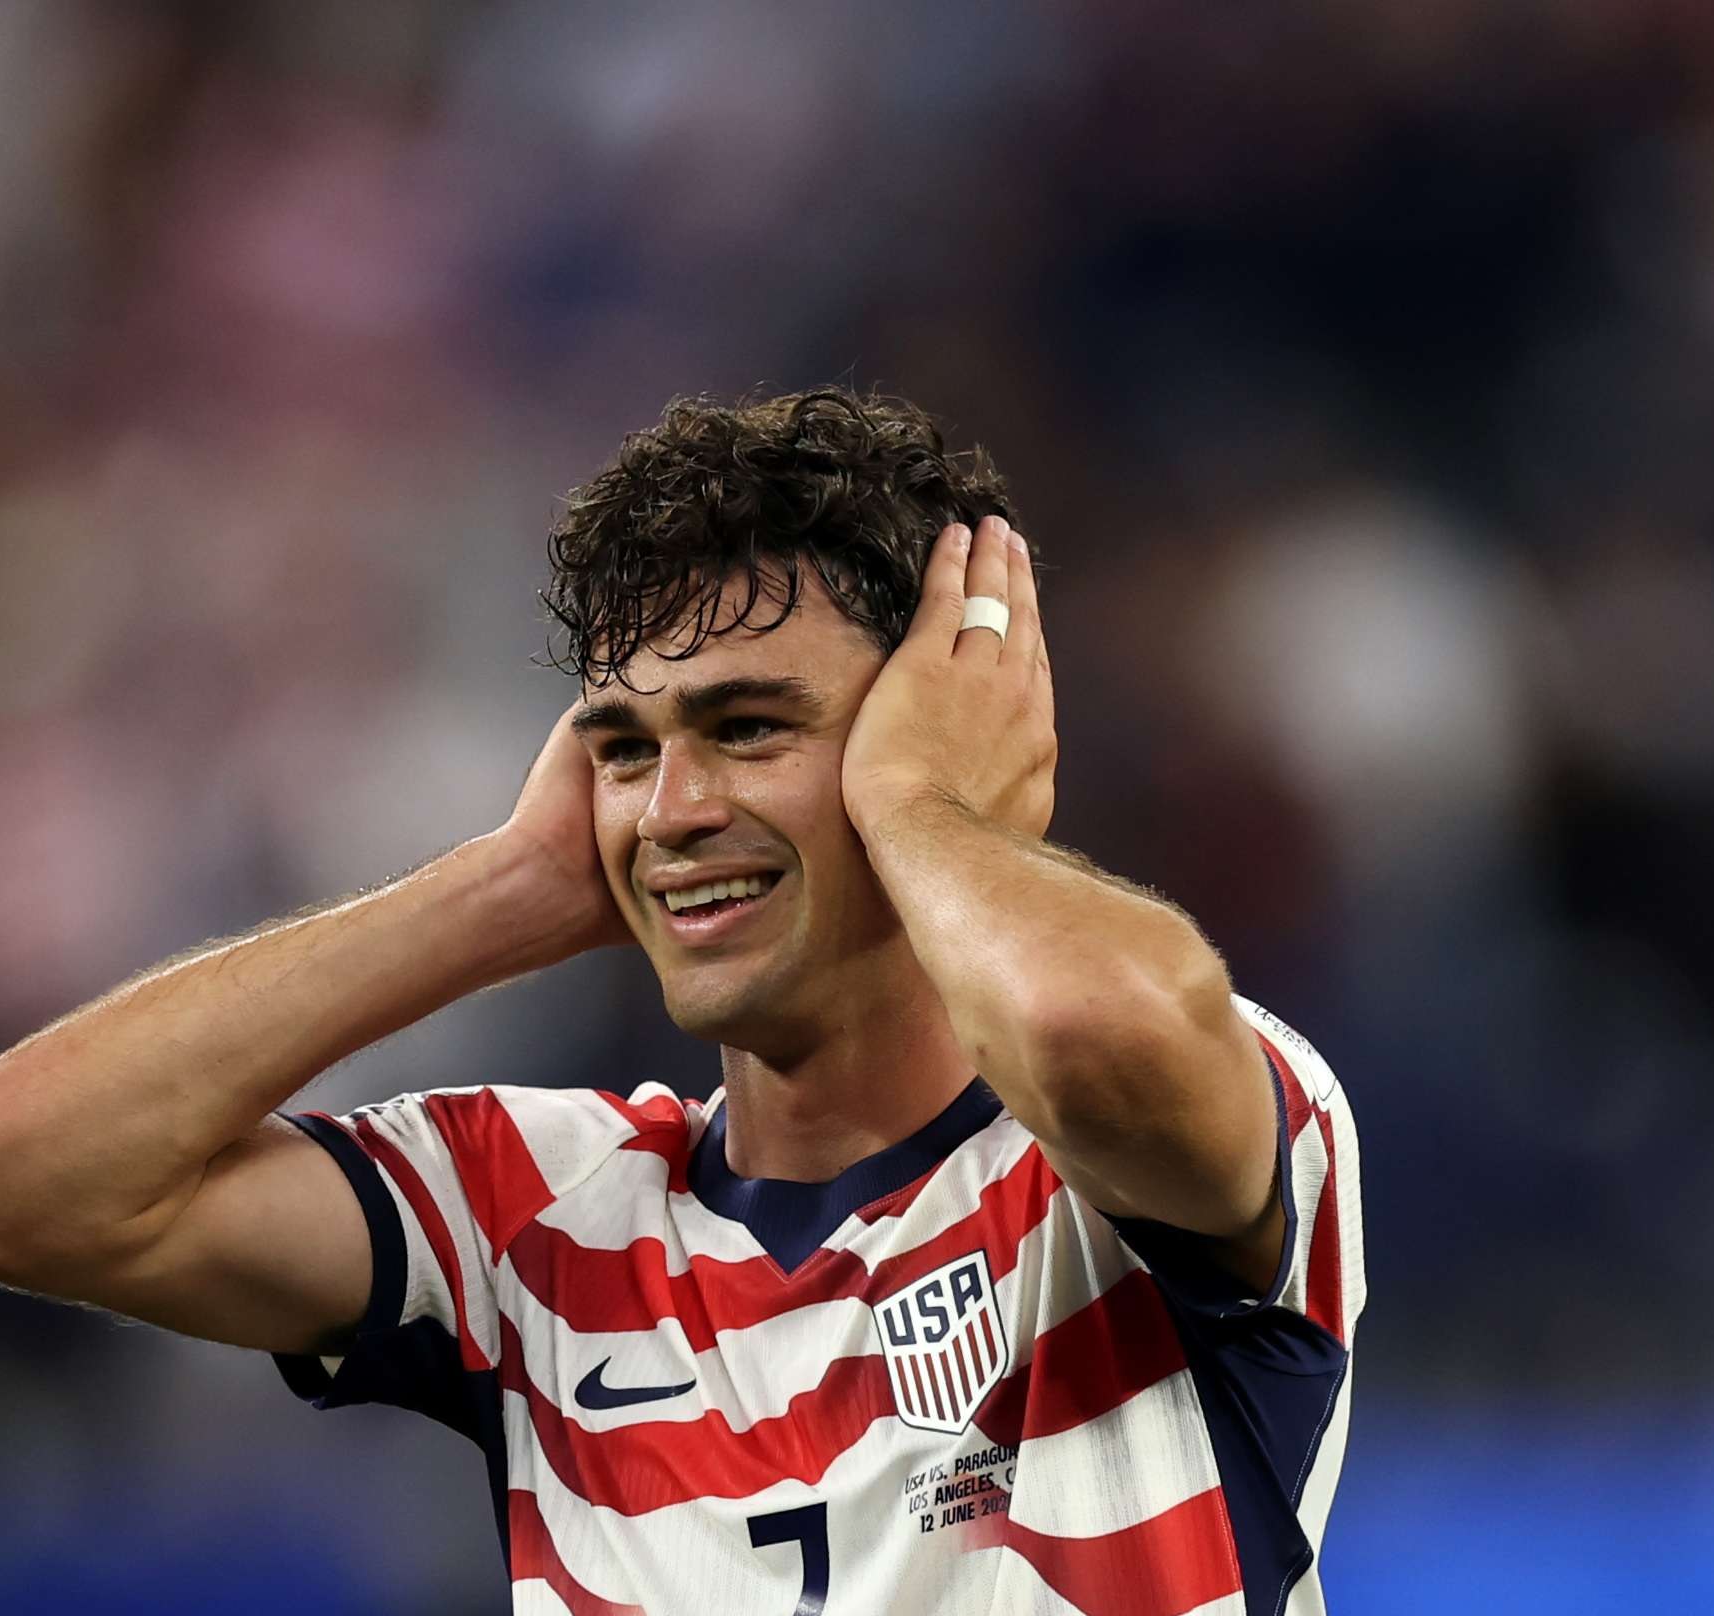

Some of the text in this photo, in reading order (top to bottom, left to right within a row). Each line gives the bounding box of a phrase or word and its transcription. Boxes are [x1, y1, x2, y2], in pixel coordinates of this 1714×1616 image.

[883, 1262, 983, 1347] USA
[905, 1445, 1019, 1495] USA VS. PARAGUA
[909, 1490, 928, 1514] LOS
[1005, 1466, 1017, 1486] C
[920, 1492, 1012, 1534] 12 JUNE 202
